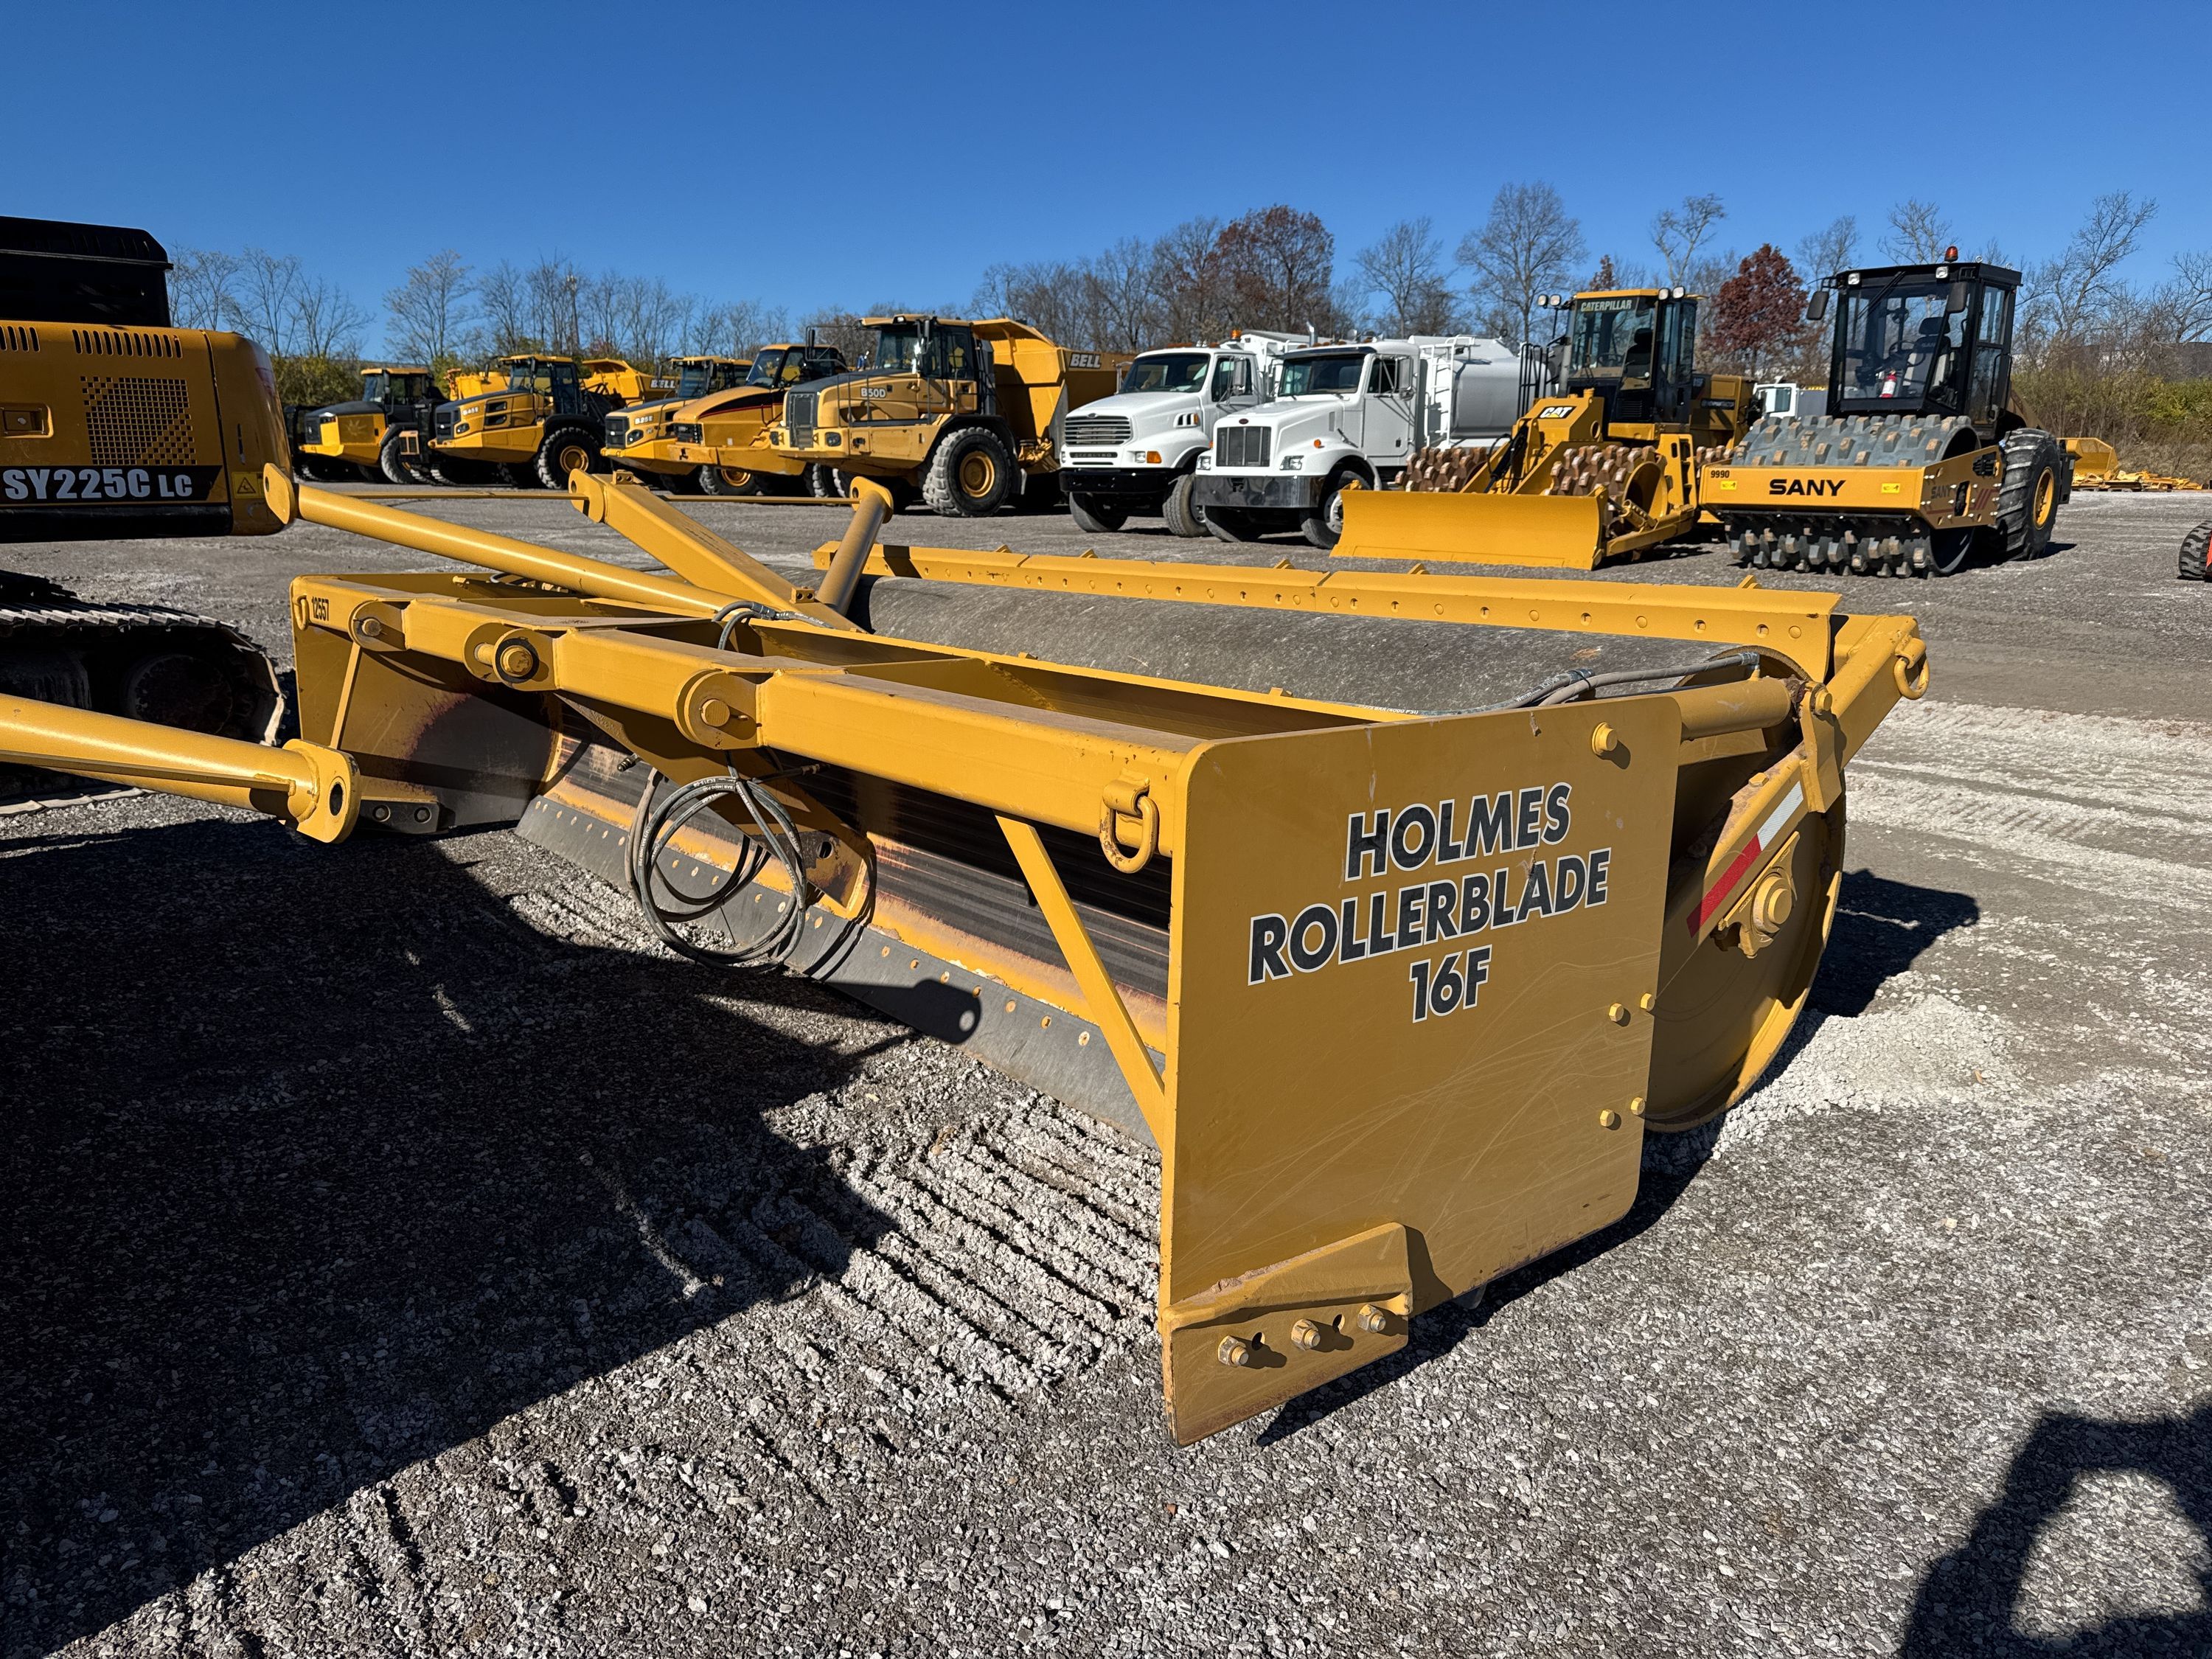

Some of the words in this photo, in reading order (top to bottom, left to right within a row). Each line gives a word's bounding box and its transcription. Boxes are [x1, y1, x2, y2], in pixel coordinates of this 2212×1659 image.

[1580, 299, 1632, 312] CATERPILLAR
[1070, 353, 1102, 369] BELL
[650, 379, 676, 389] BELL
[860, 387, 886, 399] B50D
[1539, 406, 1573, 419] CAT
[1710, 470, 1730, 479] 9990
[2, 469, 151, 500] SY225C
[158, 475, 192, 498] LC
[1769, 479, 1846, 496] SANY
[311, 596, 329, 622] 12557
[1344, 782, 1572, 882] HOLMES
[1248, 847, 1611, 987] ROLLERBLADE
[1409, 944, 1492, 1023] 16F
